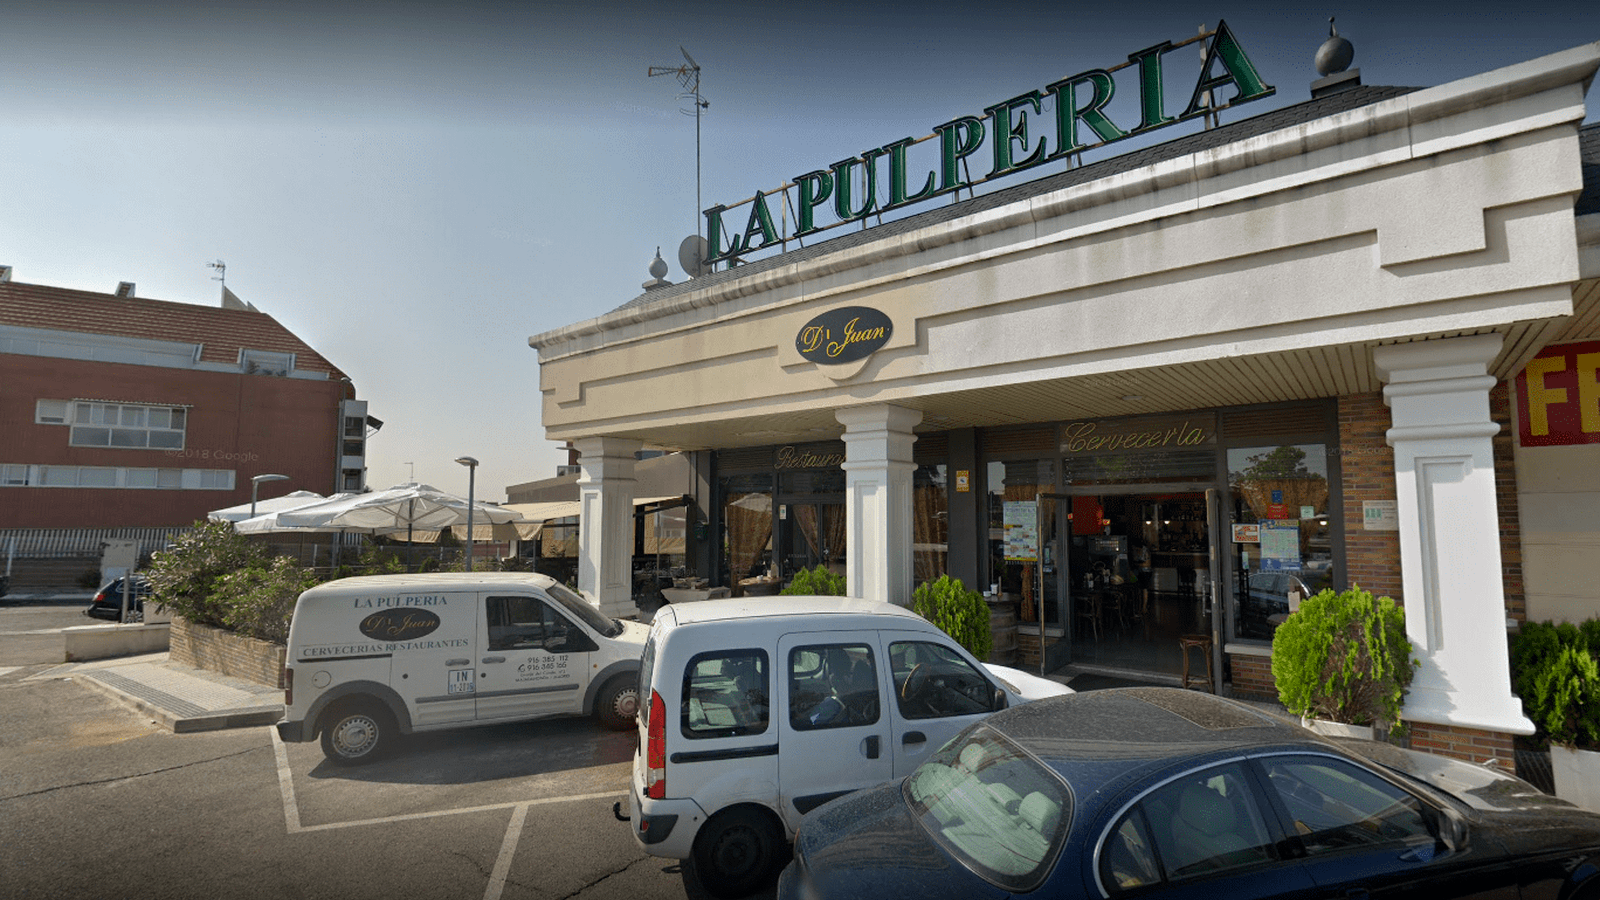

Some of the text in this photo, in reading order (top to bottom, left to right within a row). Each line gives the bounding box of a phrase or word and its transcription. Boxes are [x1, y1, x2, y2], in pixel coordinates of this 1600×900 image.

[703, 19, 1275, 266] LA PULPERIA
[827, 317, 884, 358] Juan
[354, 594, 447, 609] LA PULPERIA
[387, 613, 436, 636] Juan
[303, 638, 469, 657] CERVECERIAS RESTAURANTES
[559, 654, 569, 662] 112
[457, 671, 468, 682] IN
